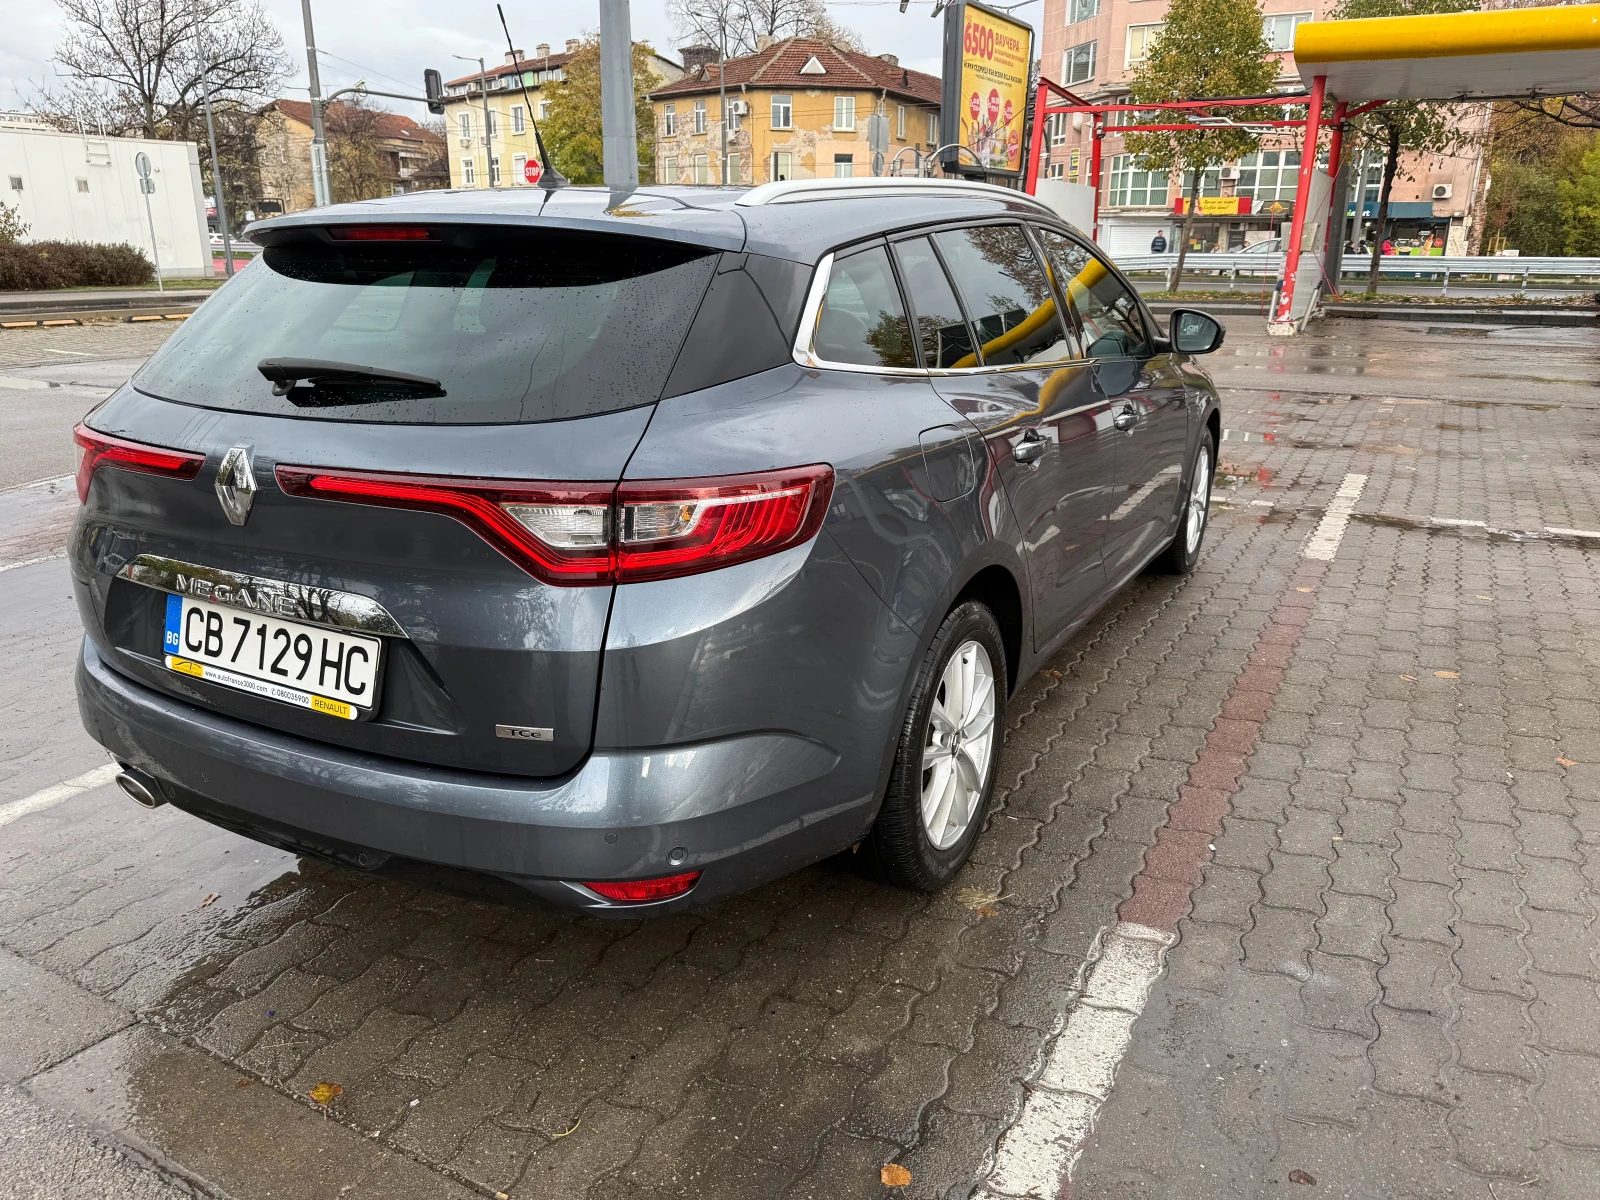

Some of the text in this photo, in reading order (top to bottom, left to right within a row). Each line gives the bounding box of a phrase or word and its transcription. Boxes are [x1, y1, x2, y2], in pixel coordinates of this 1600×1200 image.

[964, 22, 994, 60] 6500
[995, 32, 1020, 53] ВАУЧЕРА
[526, 167, 540, 177] STOP
[175, 573, 297, 617] MEGANE
[166, 630, 179, 646] BG
[185, 607, 369, 695] CB 7129 HC
[204, 670, 268, 693] www.autofrance3000.com
[314, 699, 348, 715] RENAULT
[506, 728, 542, 738] TCe
